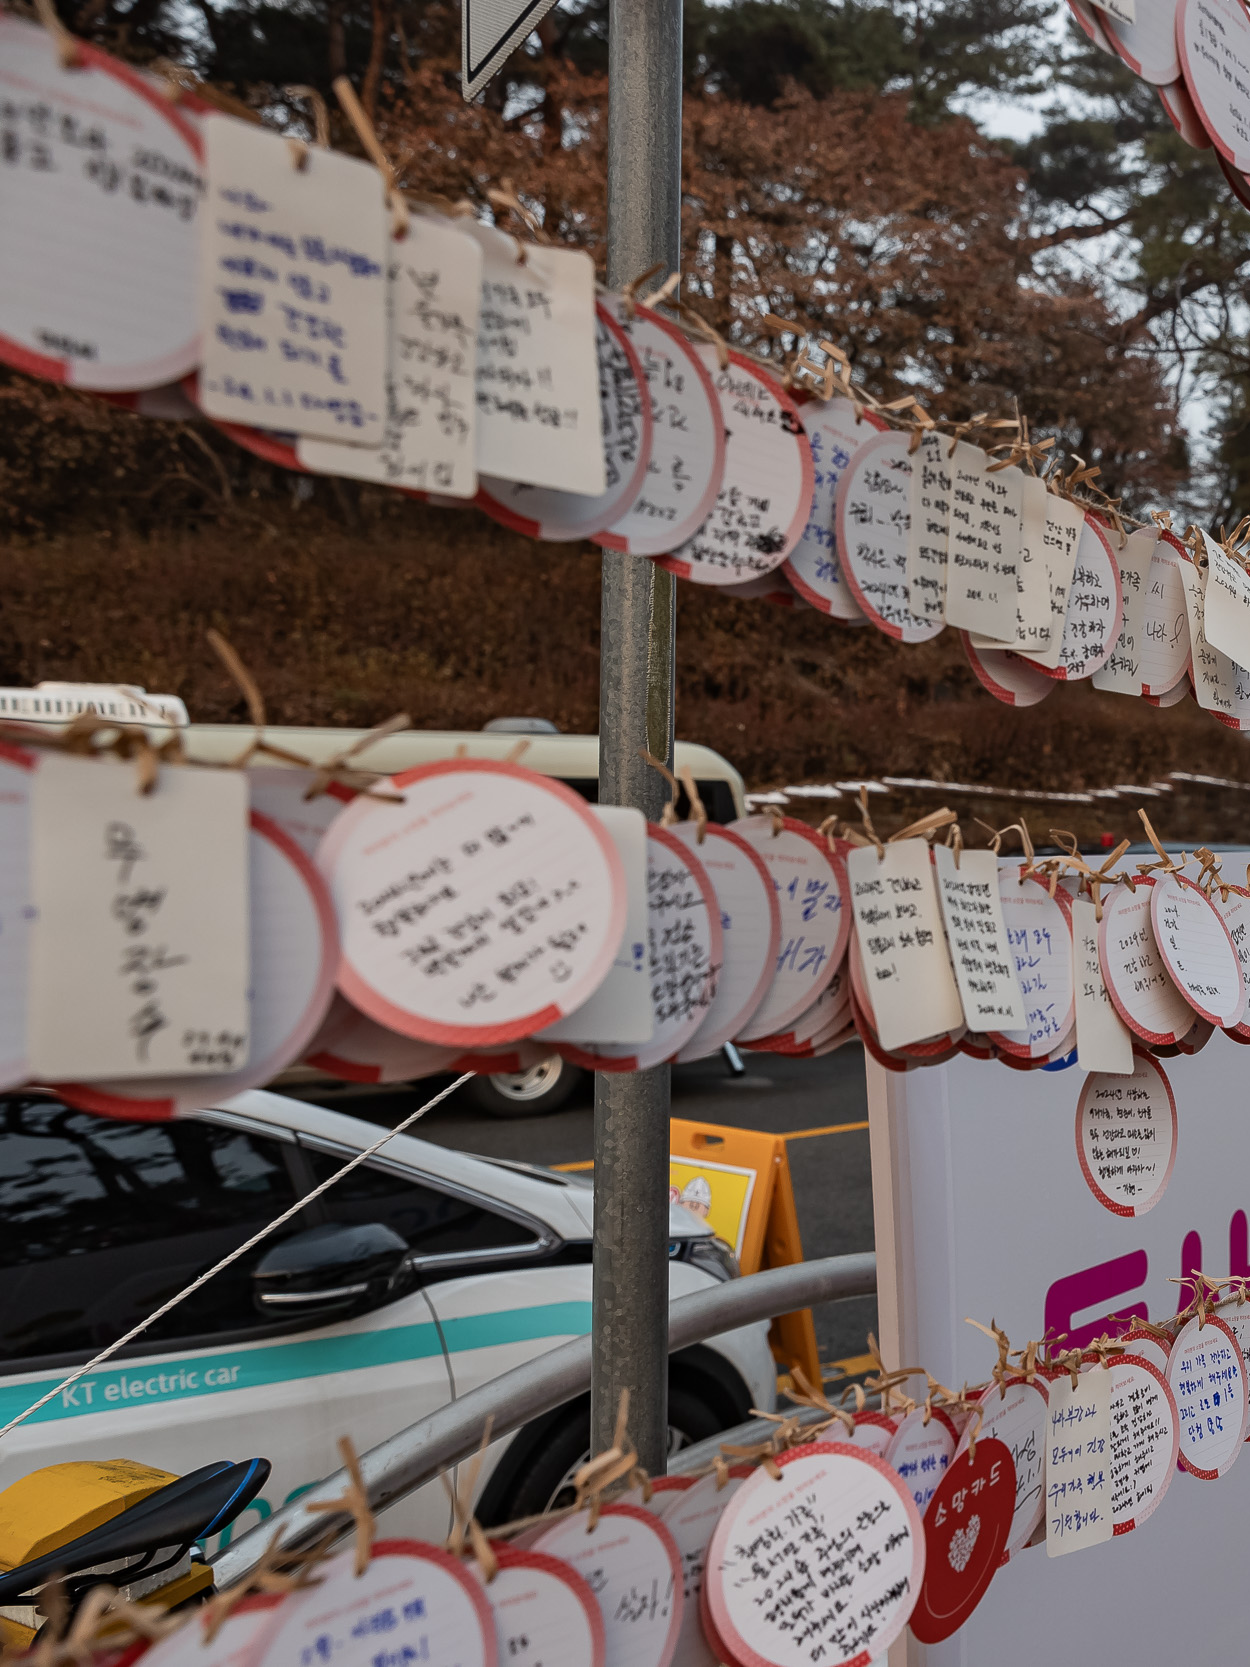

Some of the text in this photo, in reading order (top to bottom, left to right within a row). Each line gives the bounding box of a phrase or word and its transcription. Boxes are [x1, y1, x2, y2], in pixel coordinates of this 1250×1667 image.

[1180, 1347, 1231, 1373] 우리 가족 건강하고
[62, 1365, 241, 1408] KT electric car
[1179, 1376, 1204, 1396] 행복하게
[1180, 1405, 1196, 1421] 그리고
[1087, 1438, 1105, 1456] 건강
[934, 1460, 1002, 1528] 소망카드
